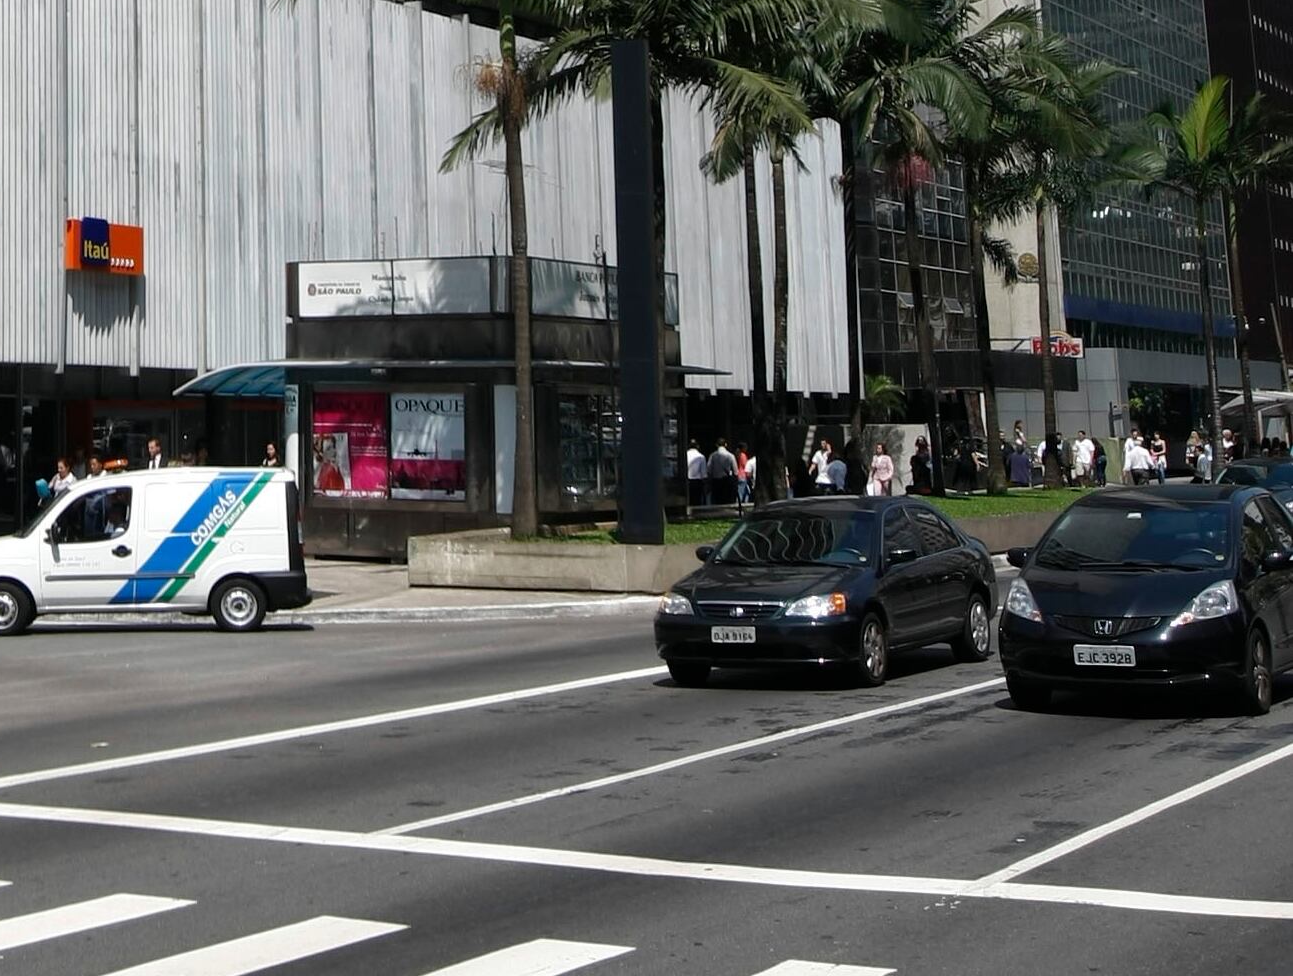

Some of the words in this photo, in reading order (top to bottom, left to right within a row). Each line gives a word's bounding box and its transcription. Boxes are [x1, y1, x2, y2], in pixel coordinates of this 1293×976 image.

[84, 240, 110, 259] Itaú
[336, 287, 361, 295] PAULO
[395, 399, 464, 414] OPAQUE
